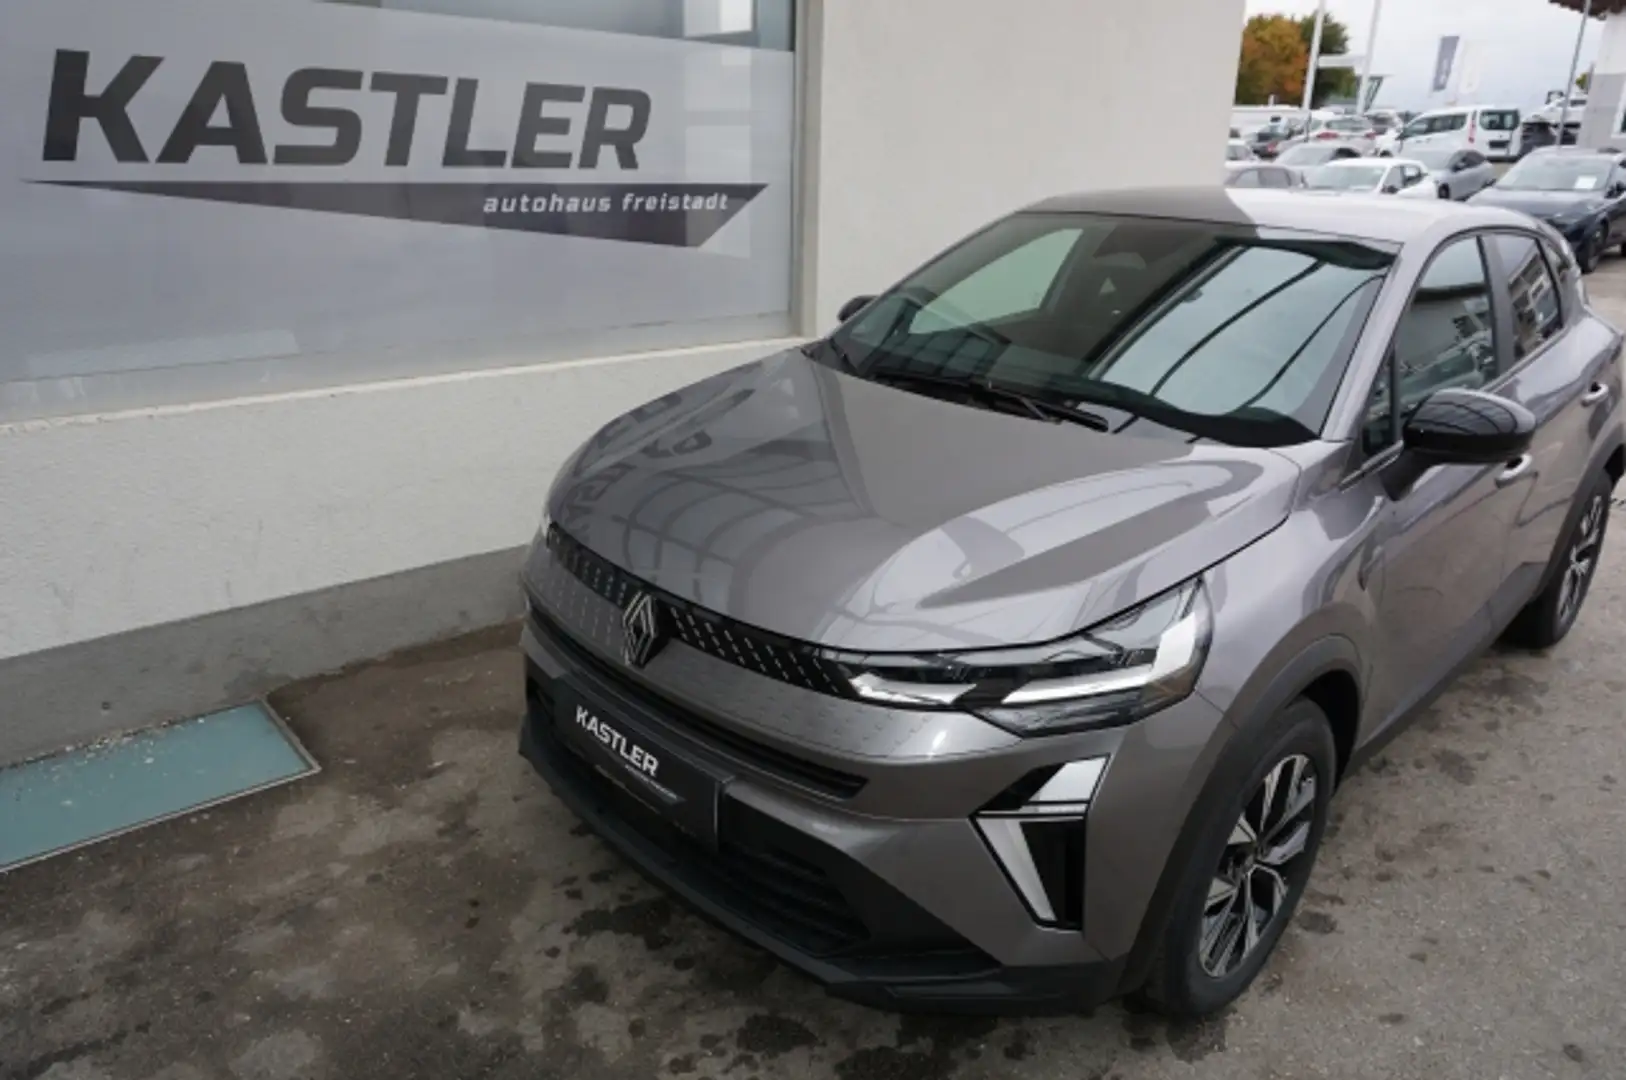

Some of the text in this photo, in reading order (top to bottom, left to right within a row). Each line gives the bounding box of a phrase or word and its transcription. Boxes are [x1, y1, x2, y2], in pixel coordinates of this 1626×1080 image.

[42, 49, 652, 169] KASTLER
[483, 193, 729, 213] autohaus freistadt
[576, 704, 659, 777] KASTLER
